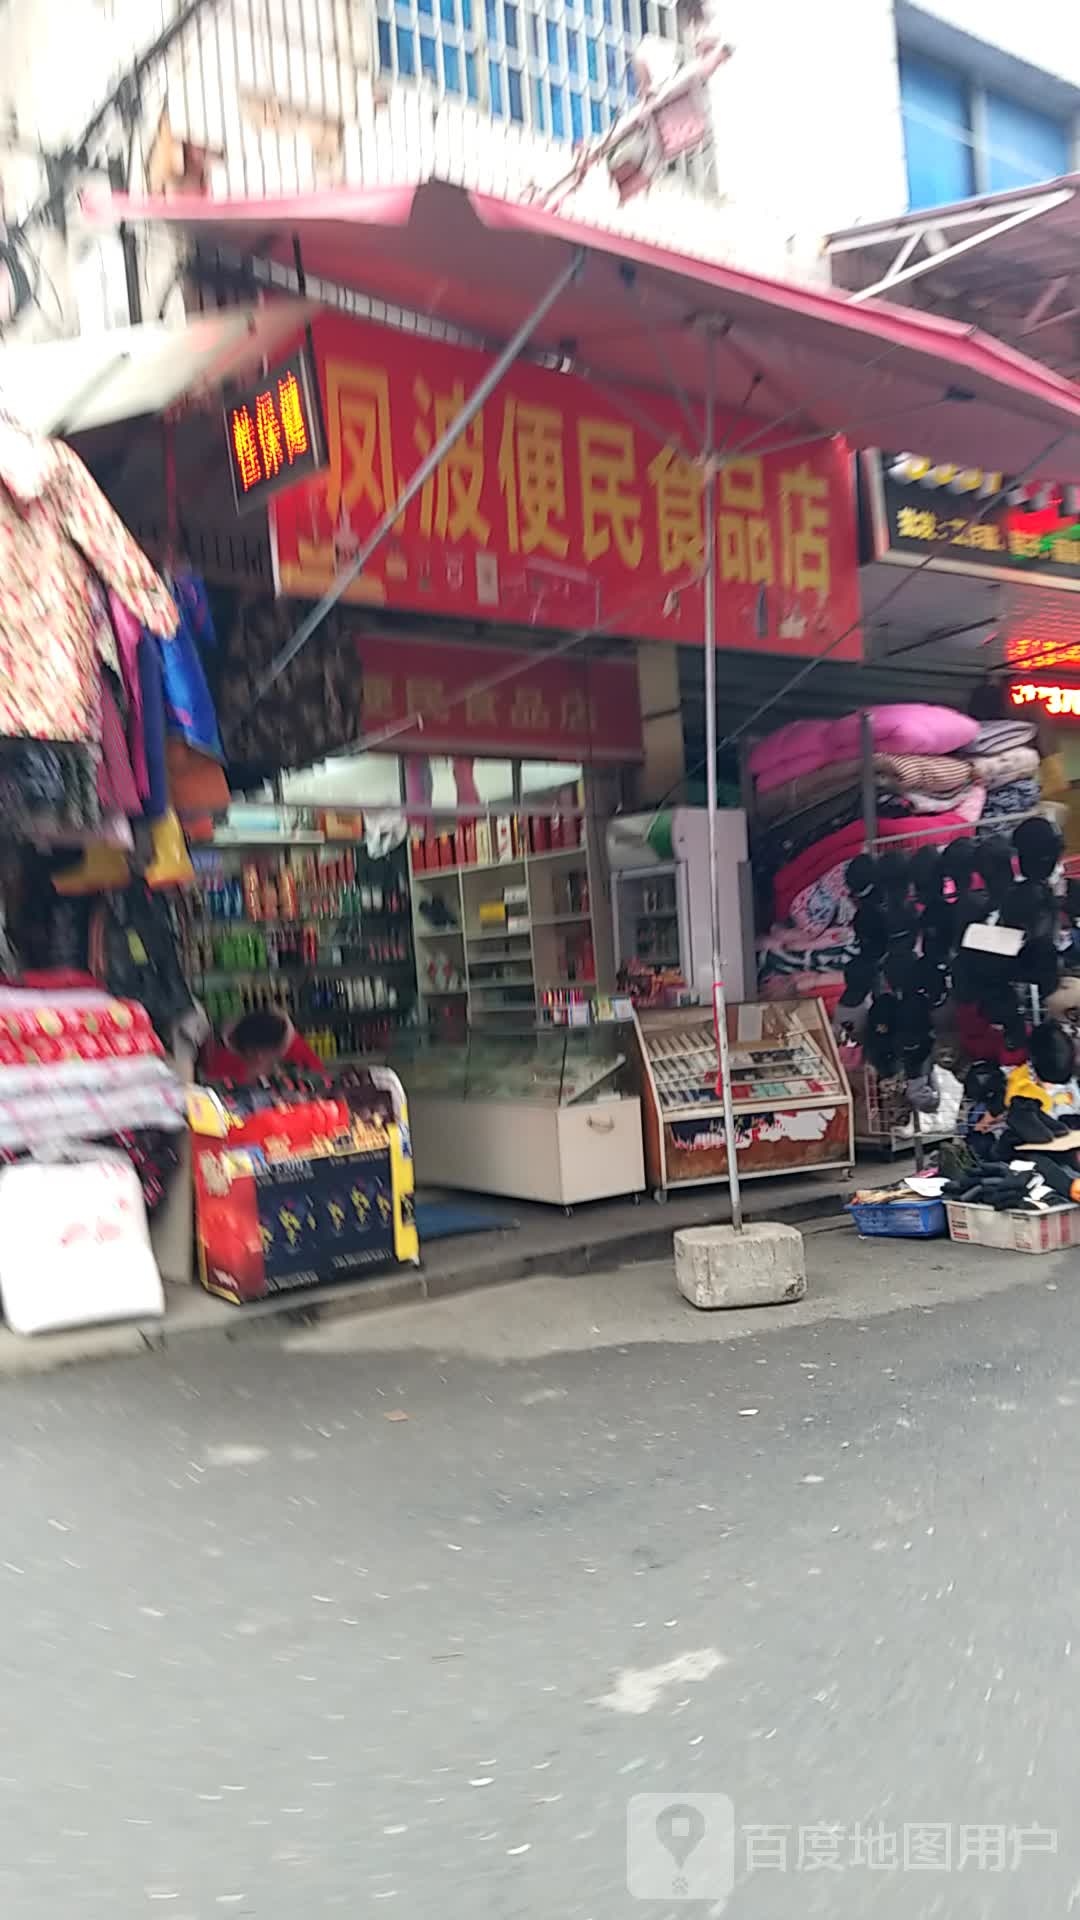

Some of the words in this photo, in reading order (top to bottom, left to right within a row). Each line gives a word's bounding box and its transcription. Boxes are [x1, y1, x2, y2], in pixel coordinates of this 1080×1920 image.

[325, 359, 832, 601] 凤波便民食品店
